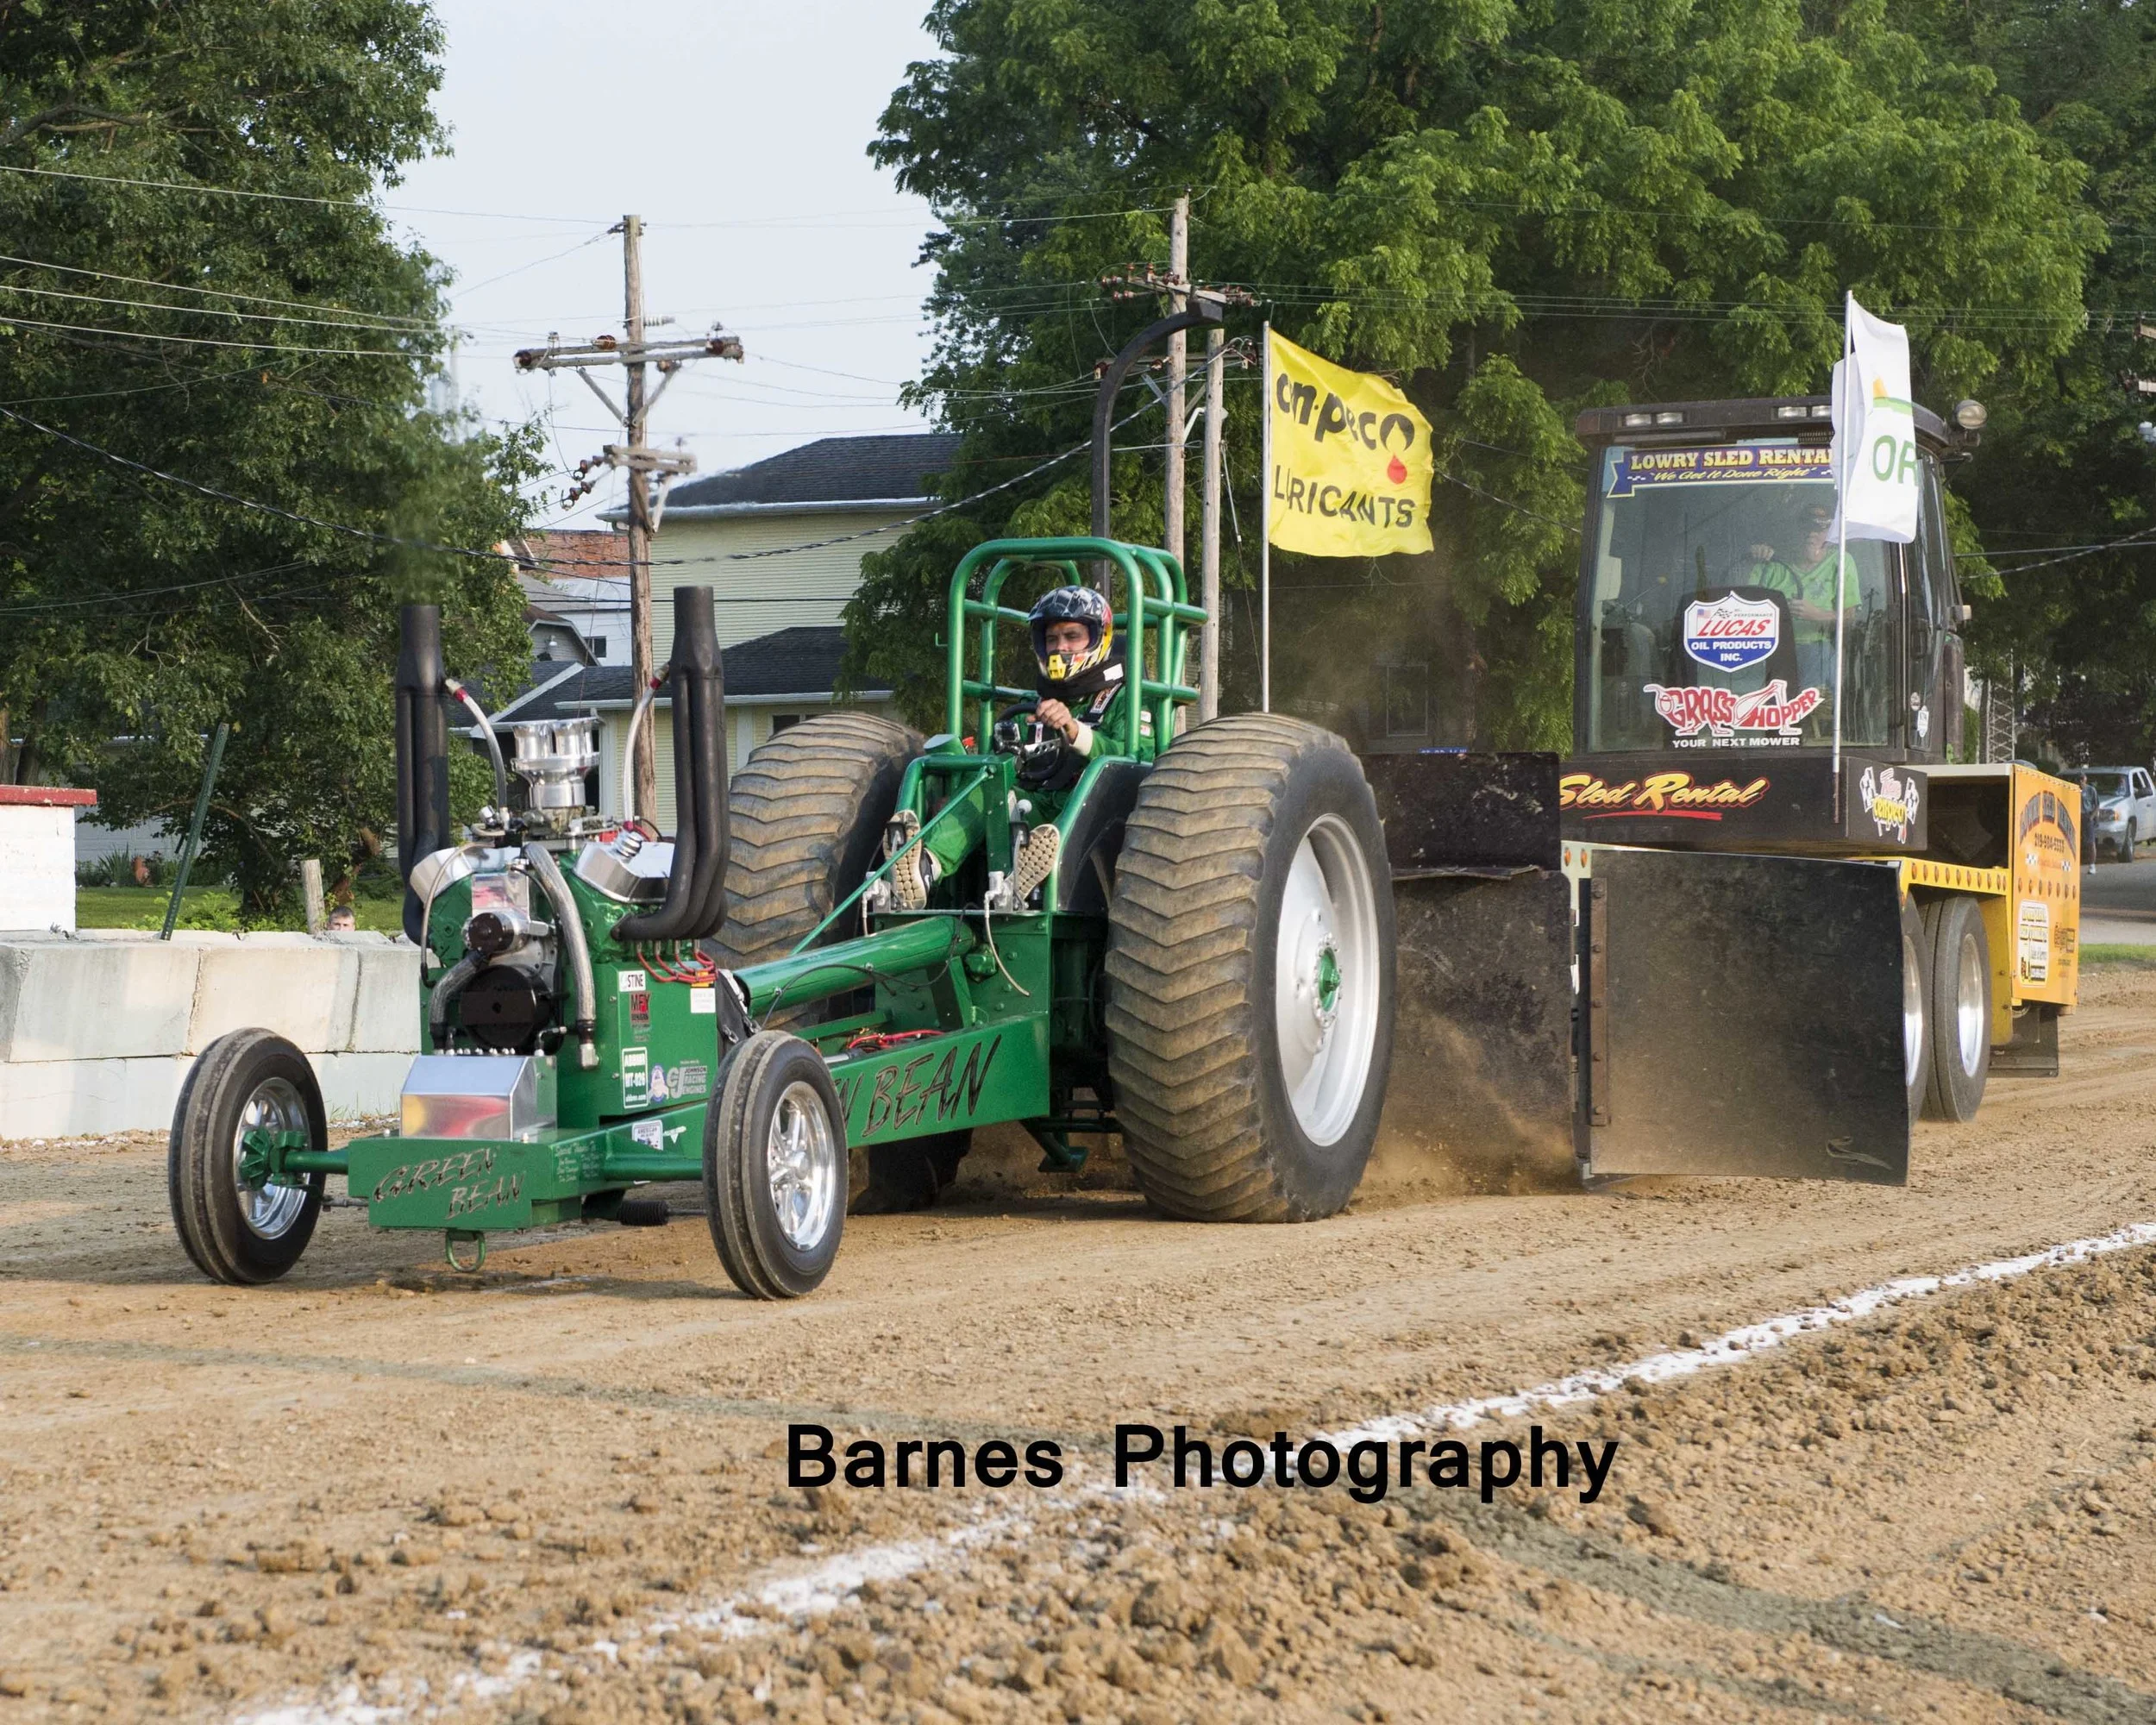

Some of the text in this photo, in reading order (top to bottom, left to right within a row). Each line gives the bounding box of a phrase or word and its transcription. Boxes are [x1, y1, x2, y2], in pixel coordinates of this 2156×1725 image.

[1630, 448, 1832, 471] LOWRY SLED RENTA
[1678, 471, 1707, 480] Get
[1708, 468, 1723, 479] It
[1722, 468, 1762, 479] Done
[1696, 619, 1771, 637] LUCAS
[1691, 640, 1772, 650] OIL PRODUCTS
[1720, 653, 1743, 662] INC.
[1672, 737, 1801, 749] YOUR NEXT MOWER
[1559, 772, 1767, 812] Sled Rental
[628, 974, 643, 988] STINE
[862, 1034, 1002, 1138] BEAN
[373, 1147, 498, 1203] GREEN
[444, 1171, 525, 1220] BEAN
